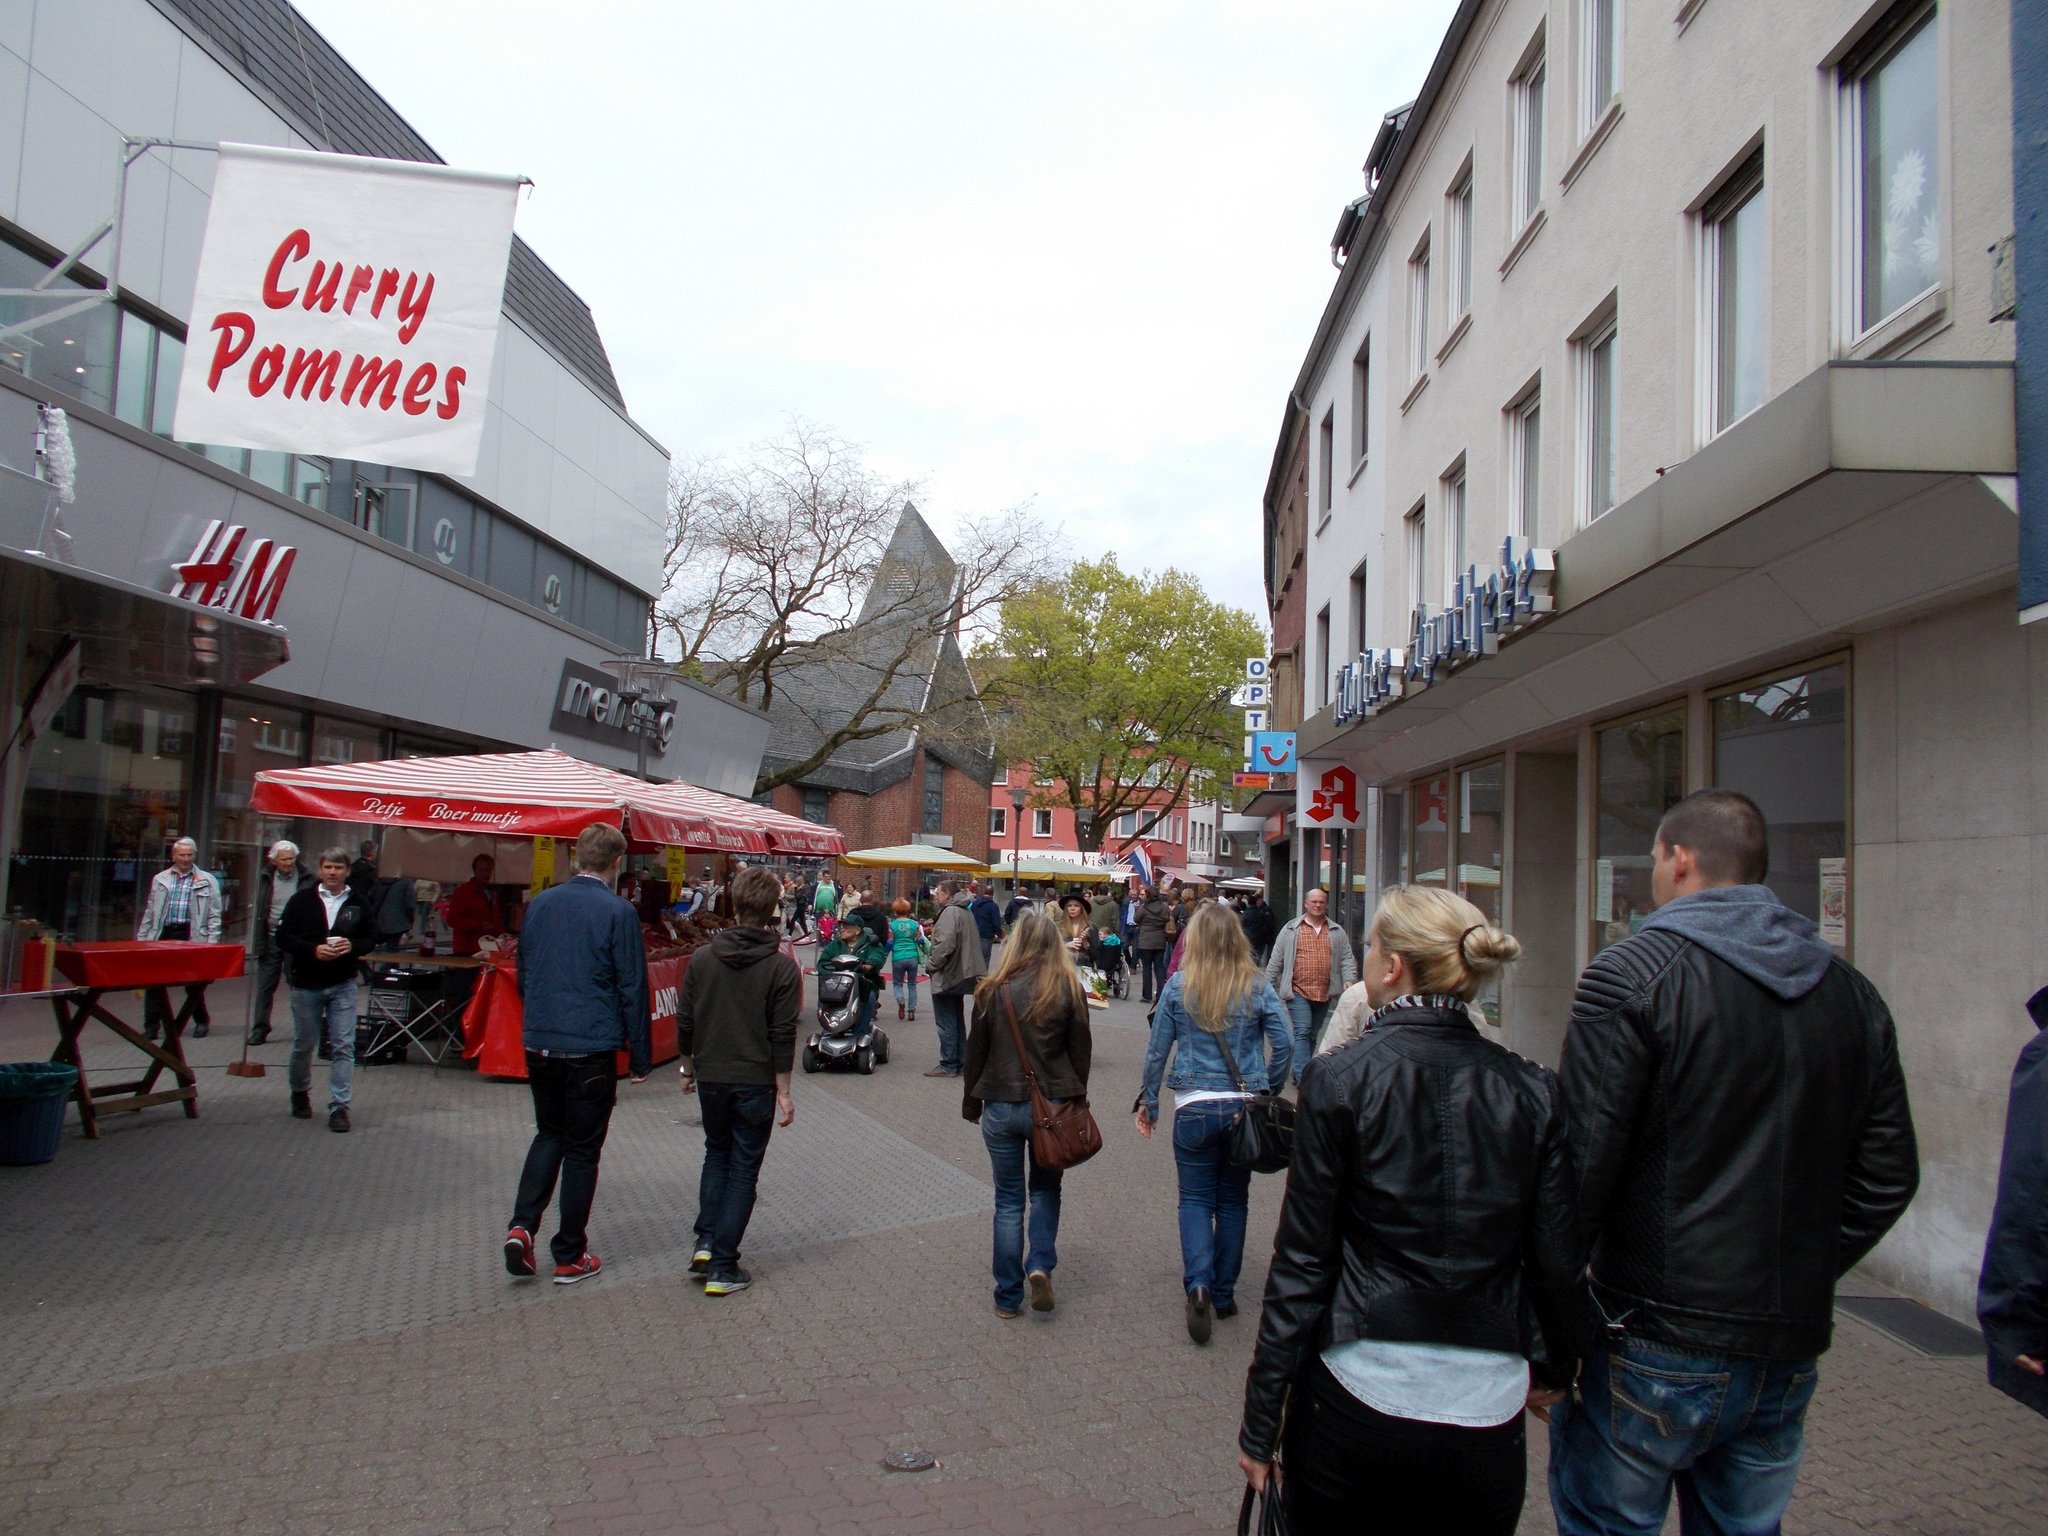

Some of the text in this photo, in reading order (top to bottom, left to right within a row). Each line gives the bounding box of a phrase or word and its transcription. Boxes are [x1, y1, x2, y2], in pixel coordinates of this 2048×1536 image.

[262, 228, 435, 345] Curry
[206, 312, 467, 421] Pommes
[170, 519, 298, 620] H&M
[360, 797, 523, 830] Petje Boer'nmetje
[651, 986, 678, 1021] AND
